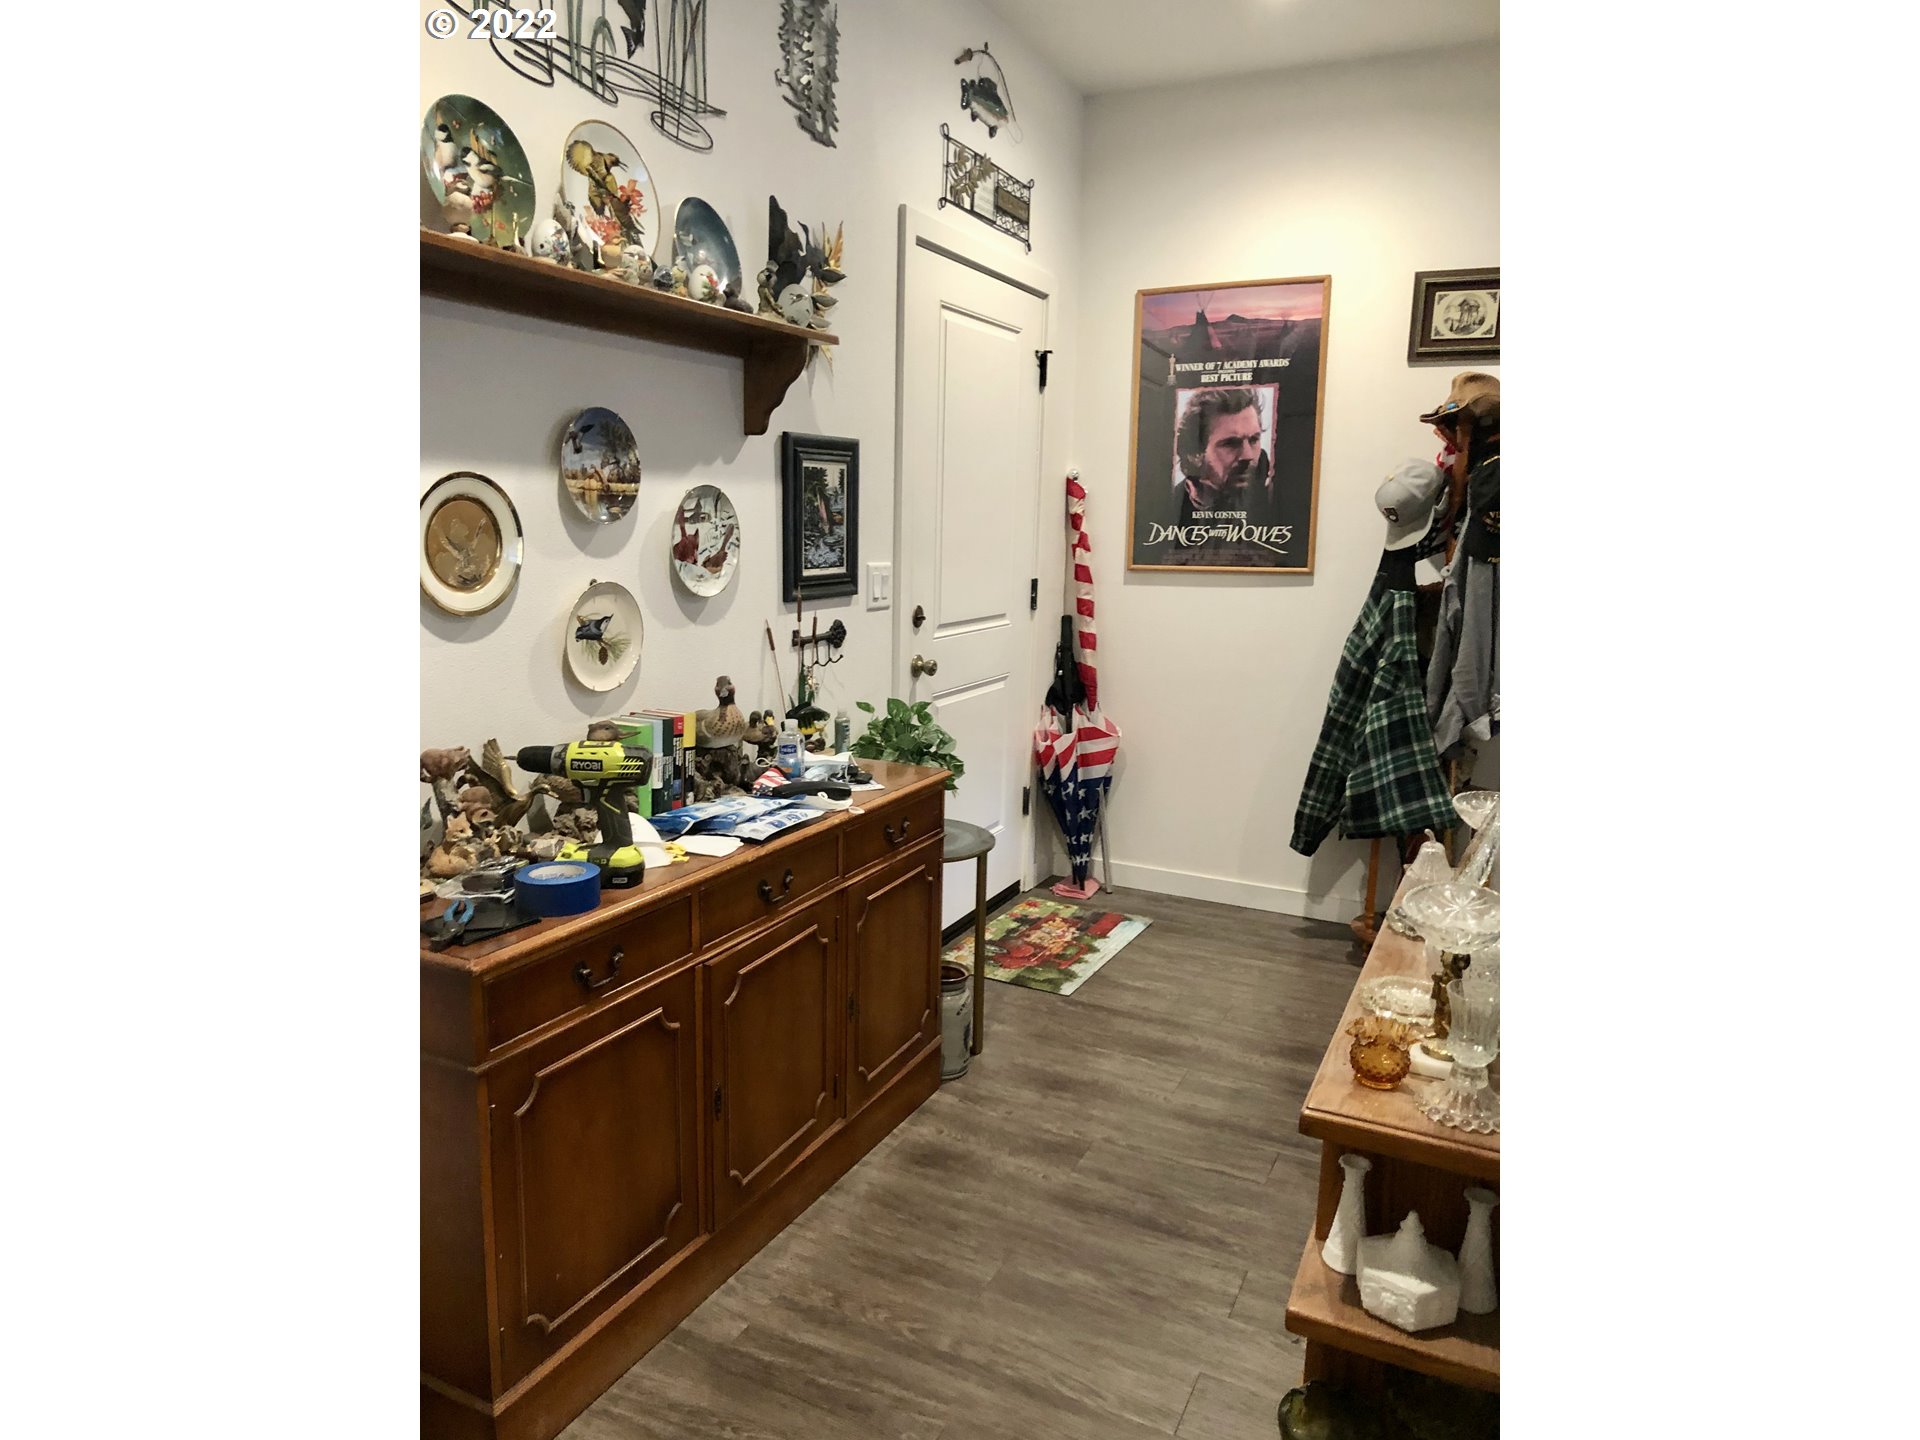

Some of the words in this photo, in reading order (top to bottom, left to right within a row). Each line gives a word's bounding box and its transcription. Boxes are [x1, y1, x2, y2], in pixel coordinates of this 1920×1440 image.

[1175, 362, 1204, 372] WINNER
[1205, 362, 1216, 370] OF
[1217, 362, 1222, 370] 7
[1223, 359, 1258, 369] ACADEMY
[1259, 358, 1291, 368] AWARDS
[1201, 374, 1219, 383] BEST
[1220, 372, 1253, 382] PICTURE
[1192, 511, 1213, 519] KEVIN
[1214, 511, 1247, 519] COSTNER
[1143, 522, 1210, 546] DANCES
[1216, 519, 1293, 554] WOLVES
[571, 760, 601, 770] RYOBI
